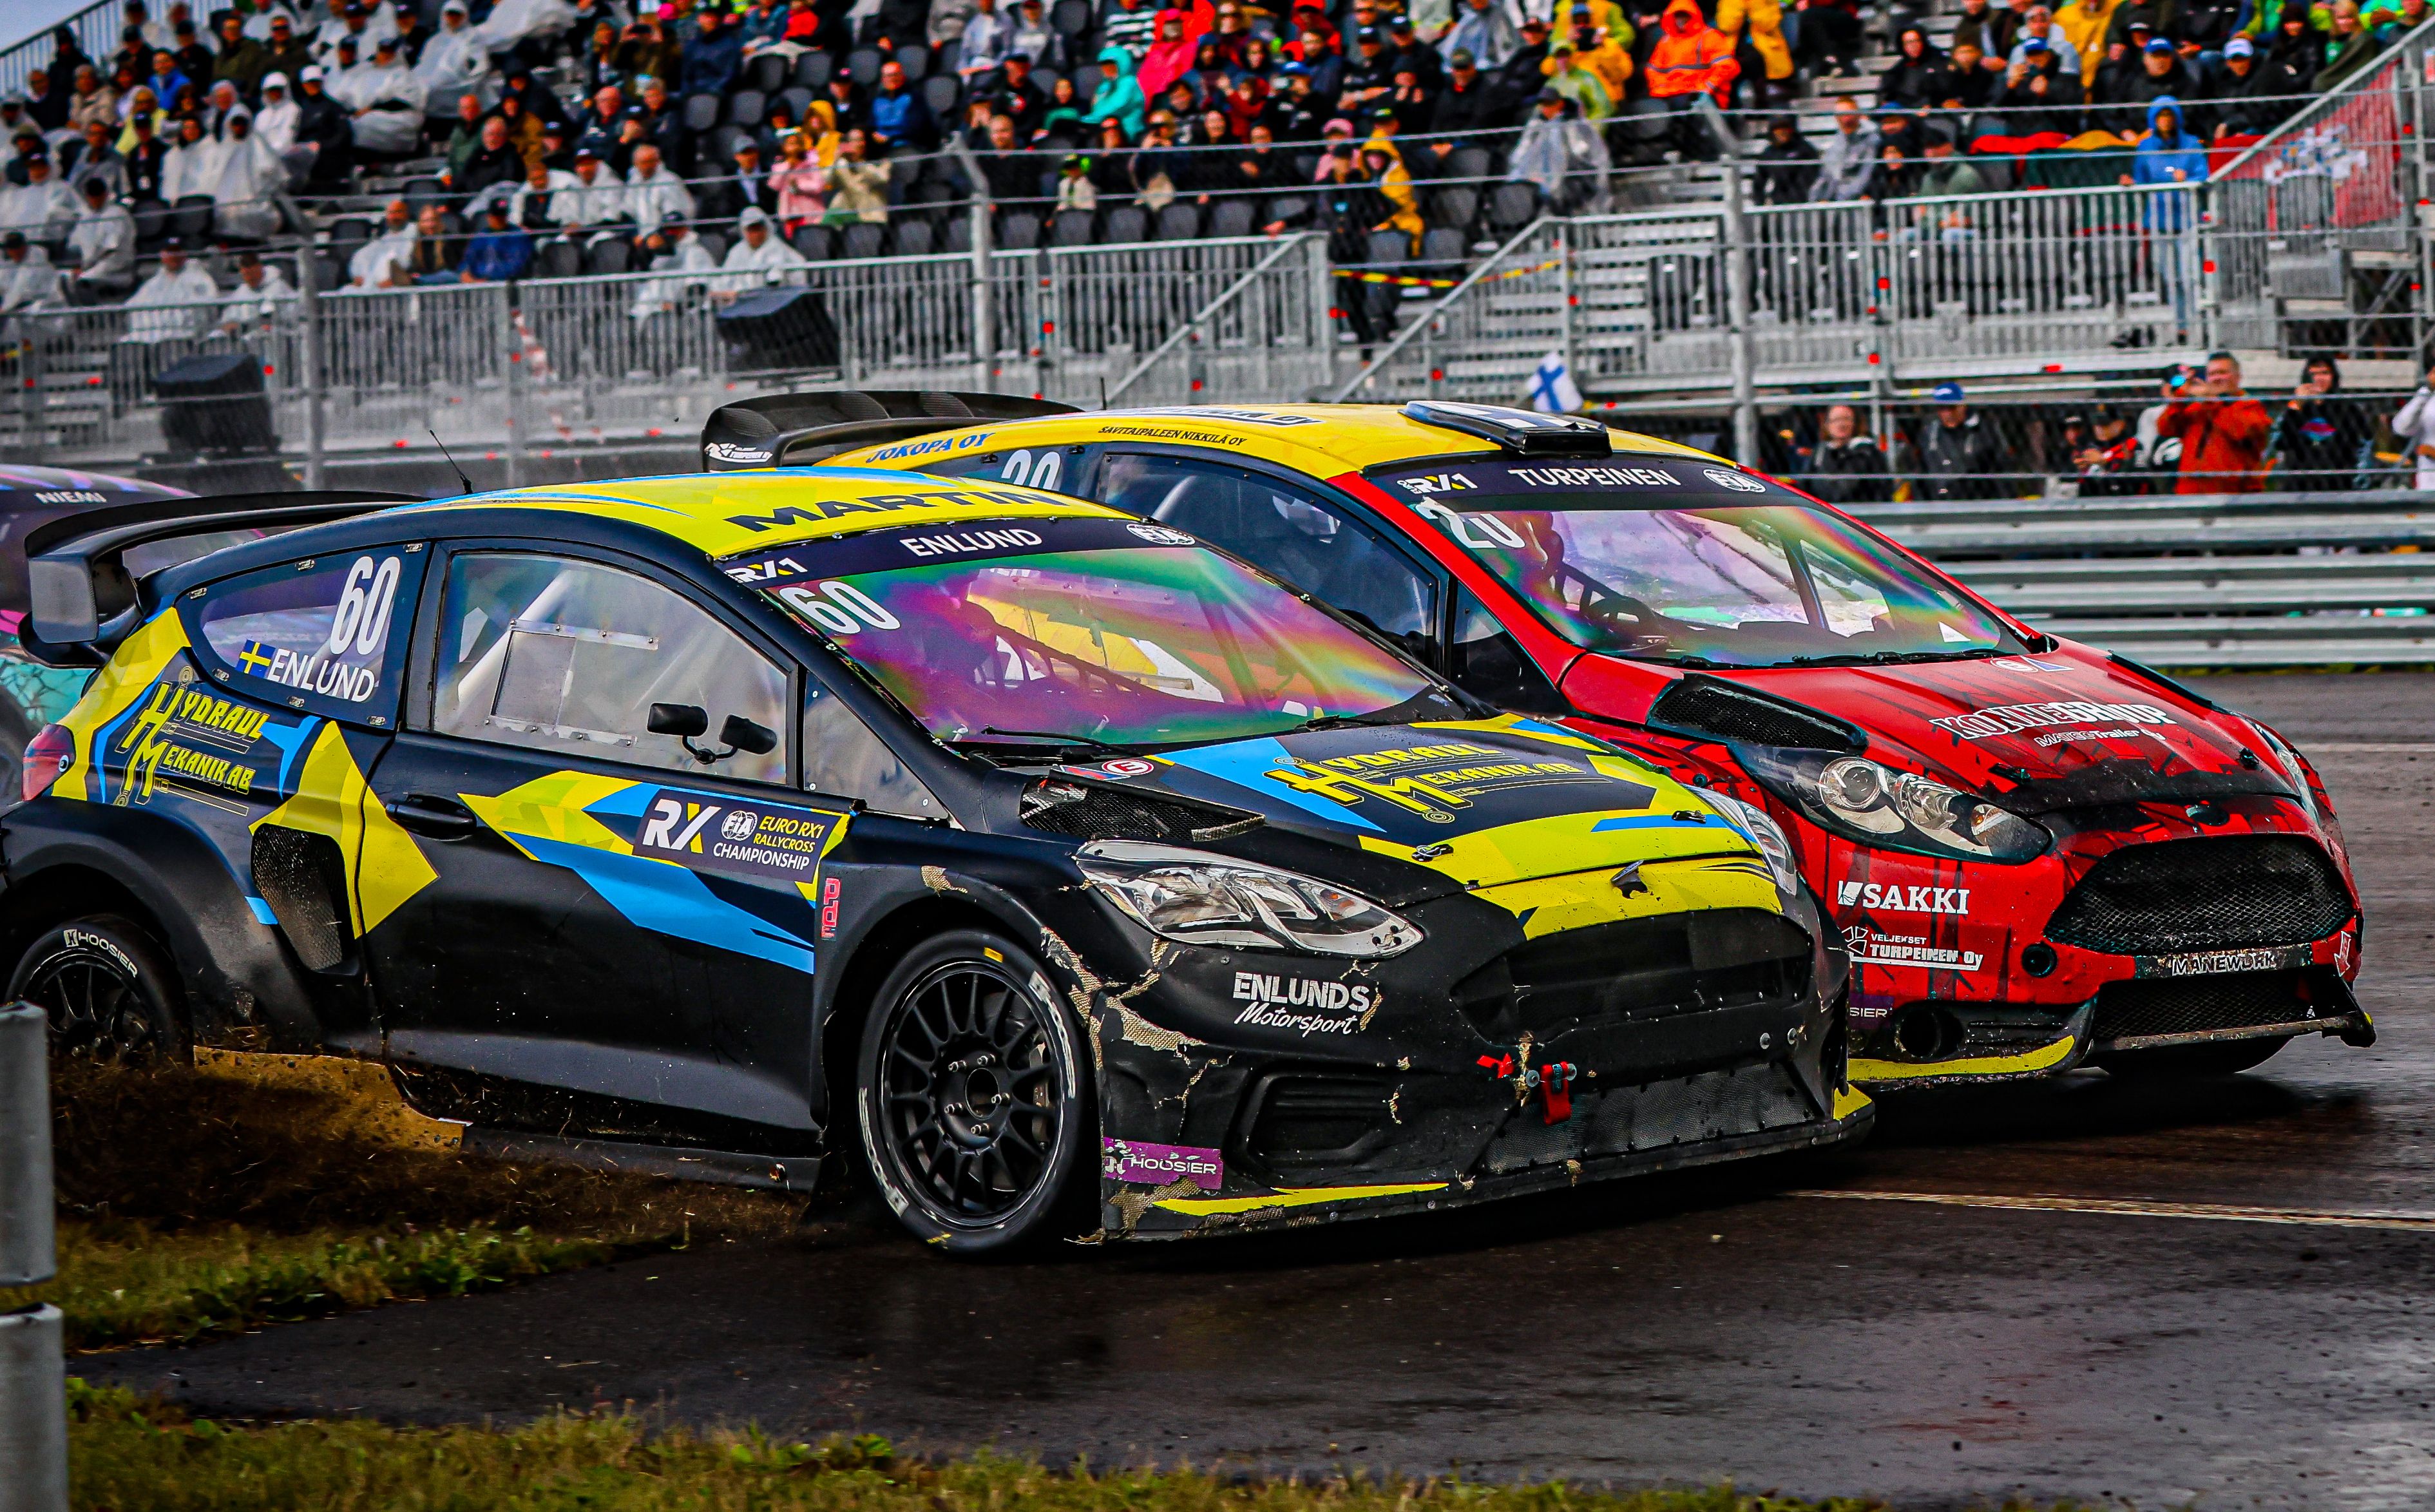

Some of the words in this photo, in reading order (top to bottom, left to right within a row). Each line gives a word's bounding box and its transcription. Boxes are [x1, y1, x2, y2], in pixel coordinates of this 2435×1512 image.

[866, 437, 955, 463] JOKOPA
[959, 432, 995, 450] OY
[1098, 426, 1181, 439] SAVITAIPALEEN
[1179, 431, 1230, 444] NIKKILÄ
[1228, 437, 1247, 446] OY
[1508, 468, 1681, 487] TURPEINEN
[35, 492, 107, 504] NIEMI
[723, 491, 1071, 533] MARTIN
[899, 528, 1042, 558] ENLUND
[329, 556, 401, 655] 60
[778, 579, 901, 635] 60
[267, 648, 376, 702] ENLUND
[118, 682, 270, 751] HYDRAUL
[122, 733, 231, 800] MEKANIK
[226, 765, 256, 794] AB
[1265, 744, 1504, 805] HYDRAUL
[1538, 763, 1584, 773] AB
[642, 799, 721, 854] RX
[759, 815, 799, 834] EURO
[797, 821, 825, 839] RX1
[713, 843, 810, 870] CHAMPIONSHIP
[753, 833, 815, 853] RALLYCROSS
[1862, 883, 1970, 914] SAKKI
[1870, 944, 1958, 962] TURPEINEN
[1871, 933, 1927, 944] VELJEKSET
[78, 932, 138, 978] HOOSIER
[2172, 951, 2277, 976] MANEWORK
[1233, 971, 1370, 1012] ENLUNDS
[1234, 1001, 1358, 1038] Motorsport
[1849, 1007, 1887, 1018] SIER
[1131, 1158, 1217, 1174] HOOSIER
